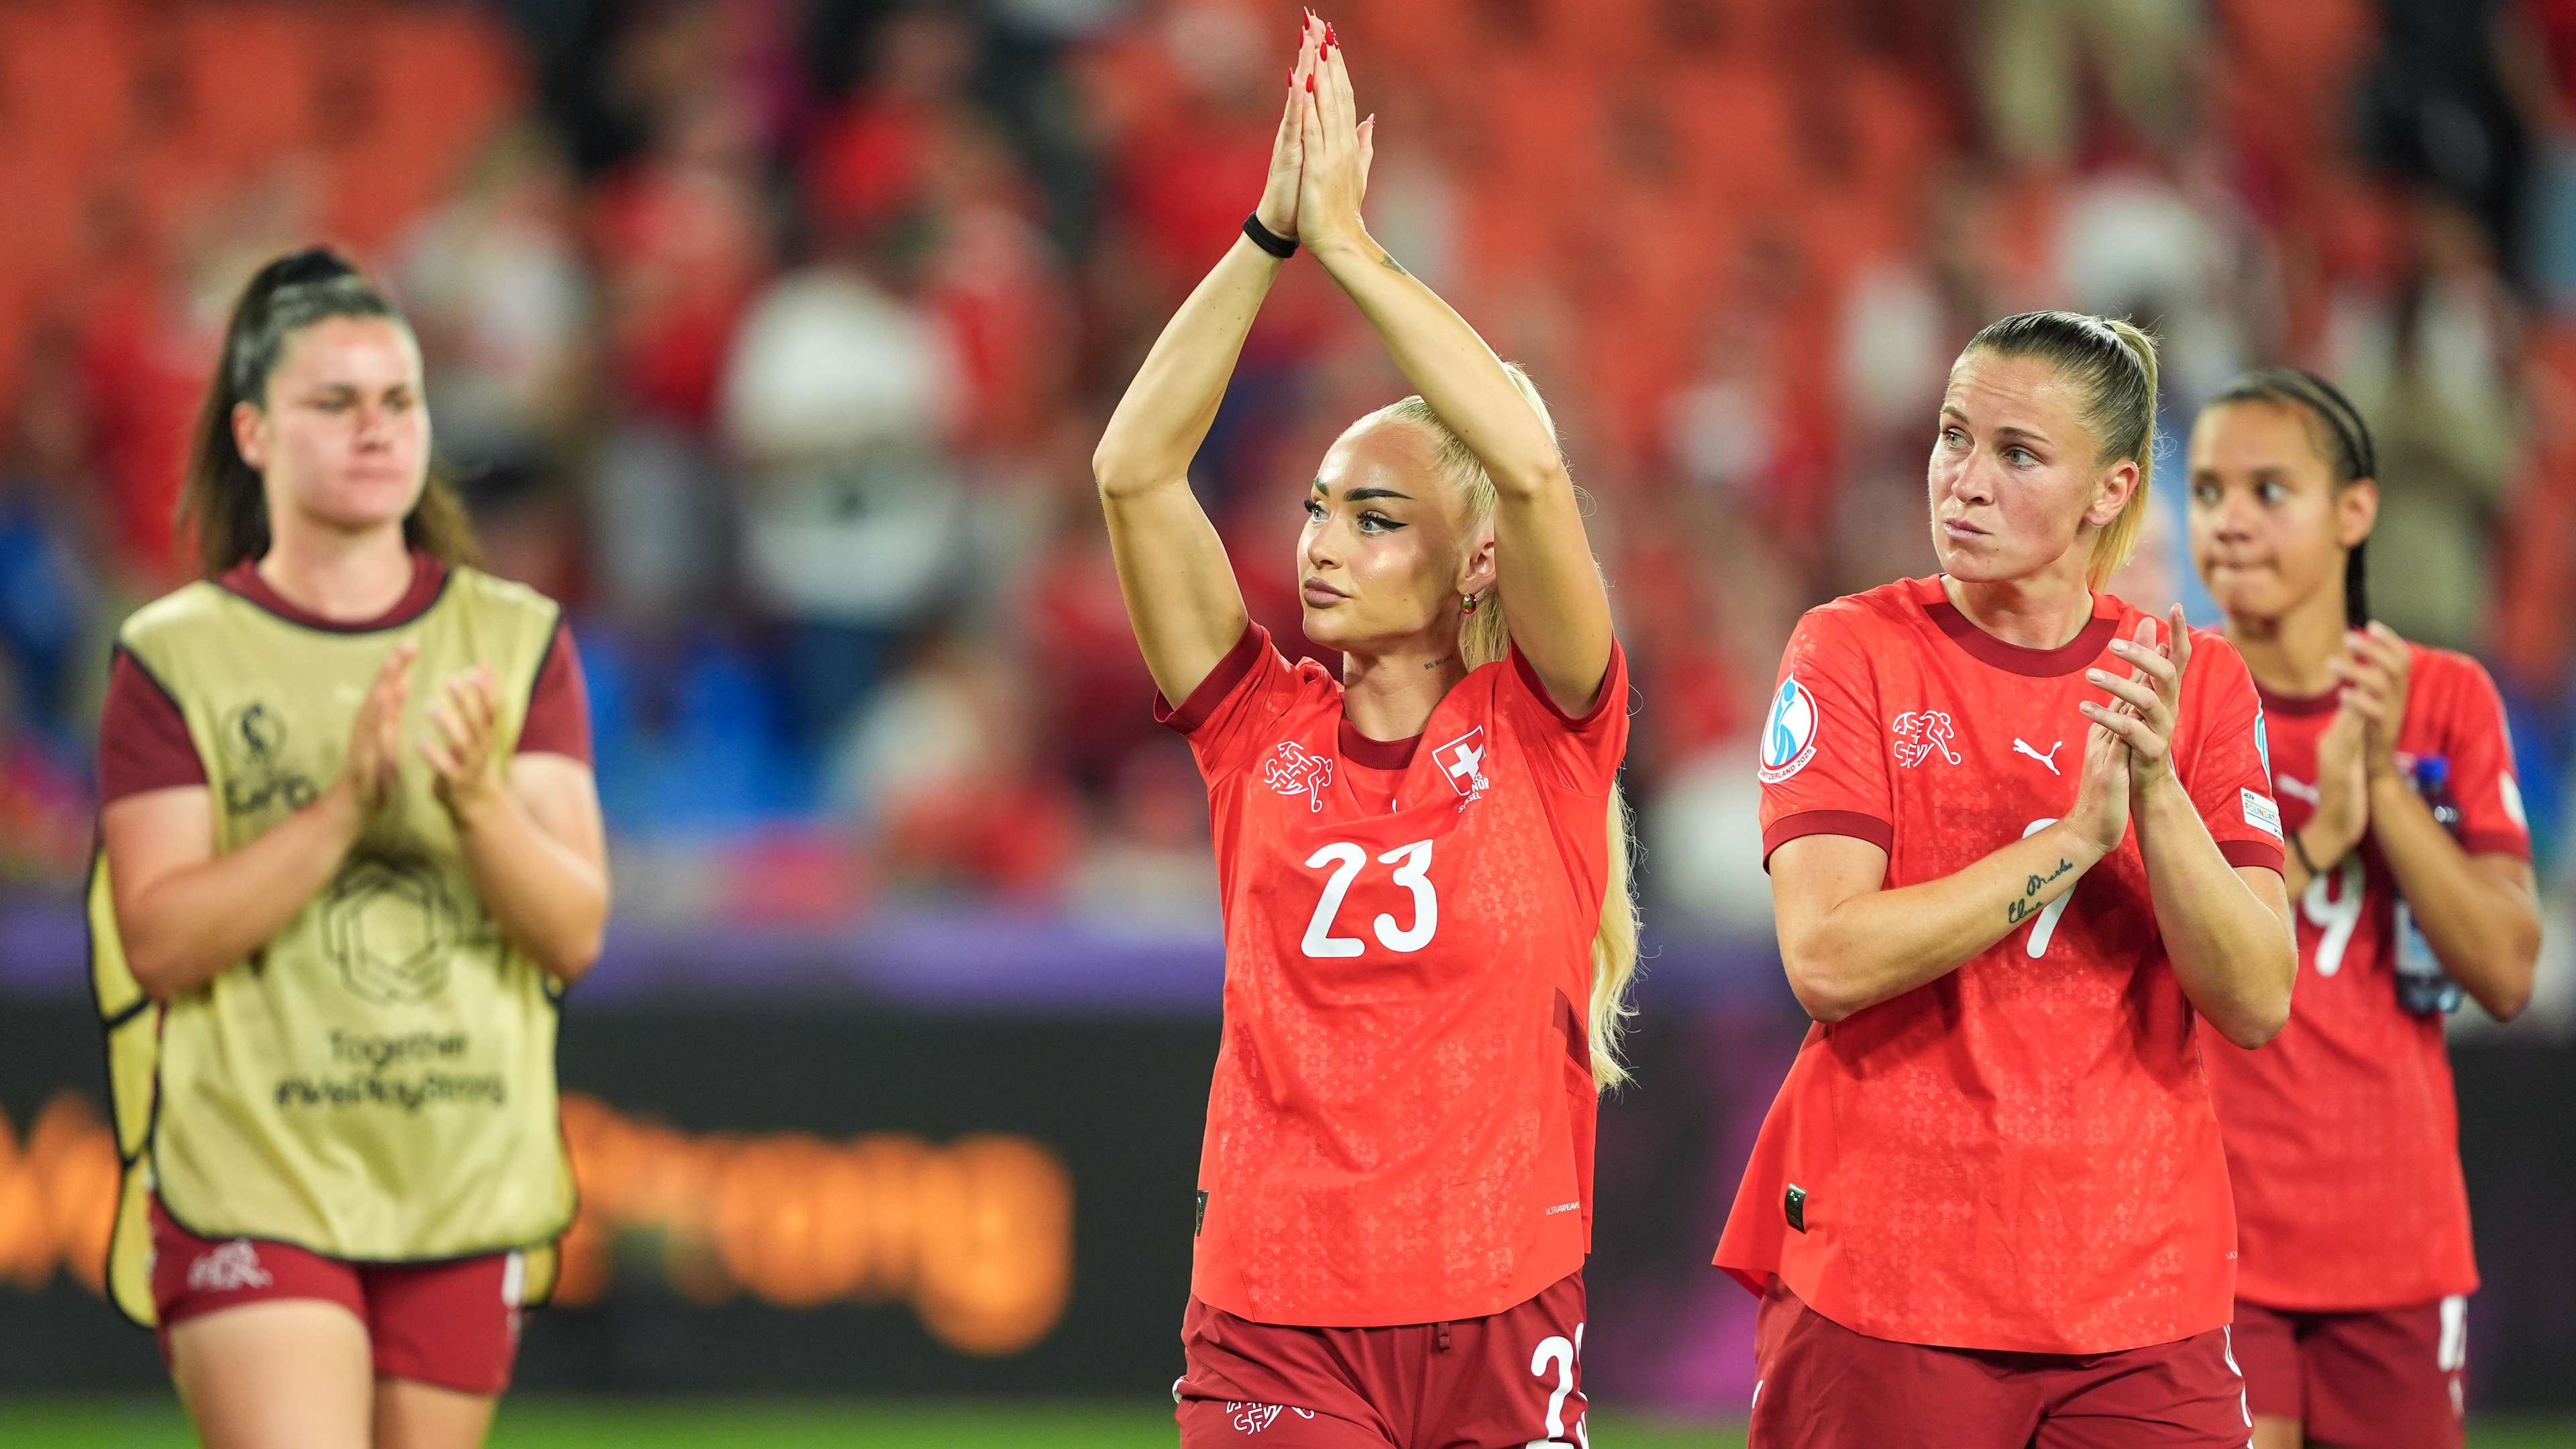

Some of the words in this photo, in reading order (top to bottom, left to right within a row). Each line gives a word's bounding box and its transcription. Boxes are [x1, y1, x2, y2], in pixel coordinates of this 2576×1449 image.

[1796, 748, 1813, 767] 2025
[1471, 777, 1489, 792] NOR
[1301, 839, 1438, 958] 23
[2289, 851, 2366, 977] 9
[1546, 1201, 1580, 1216] ULTRAWEAVE
